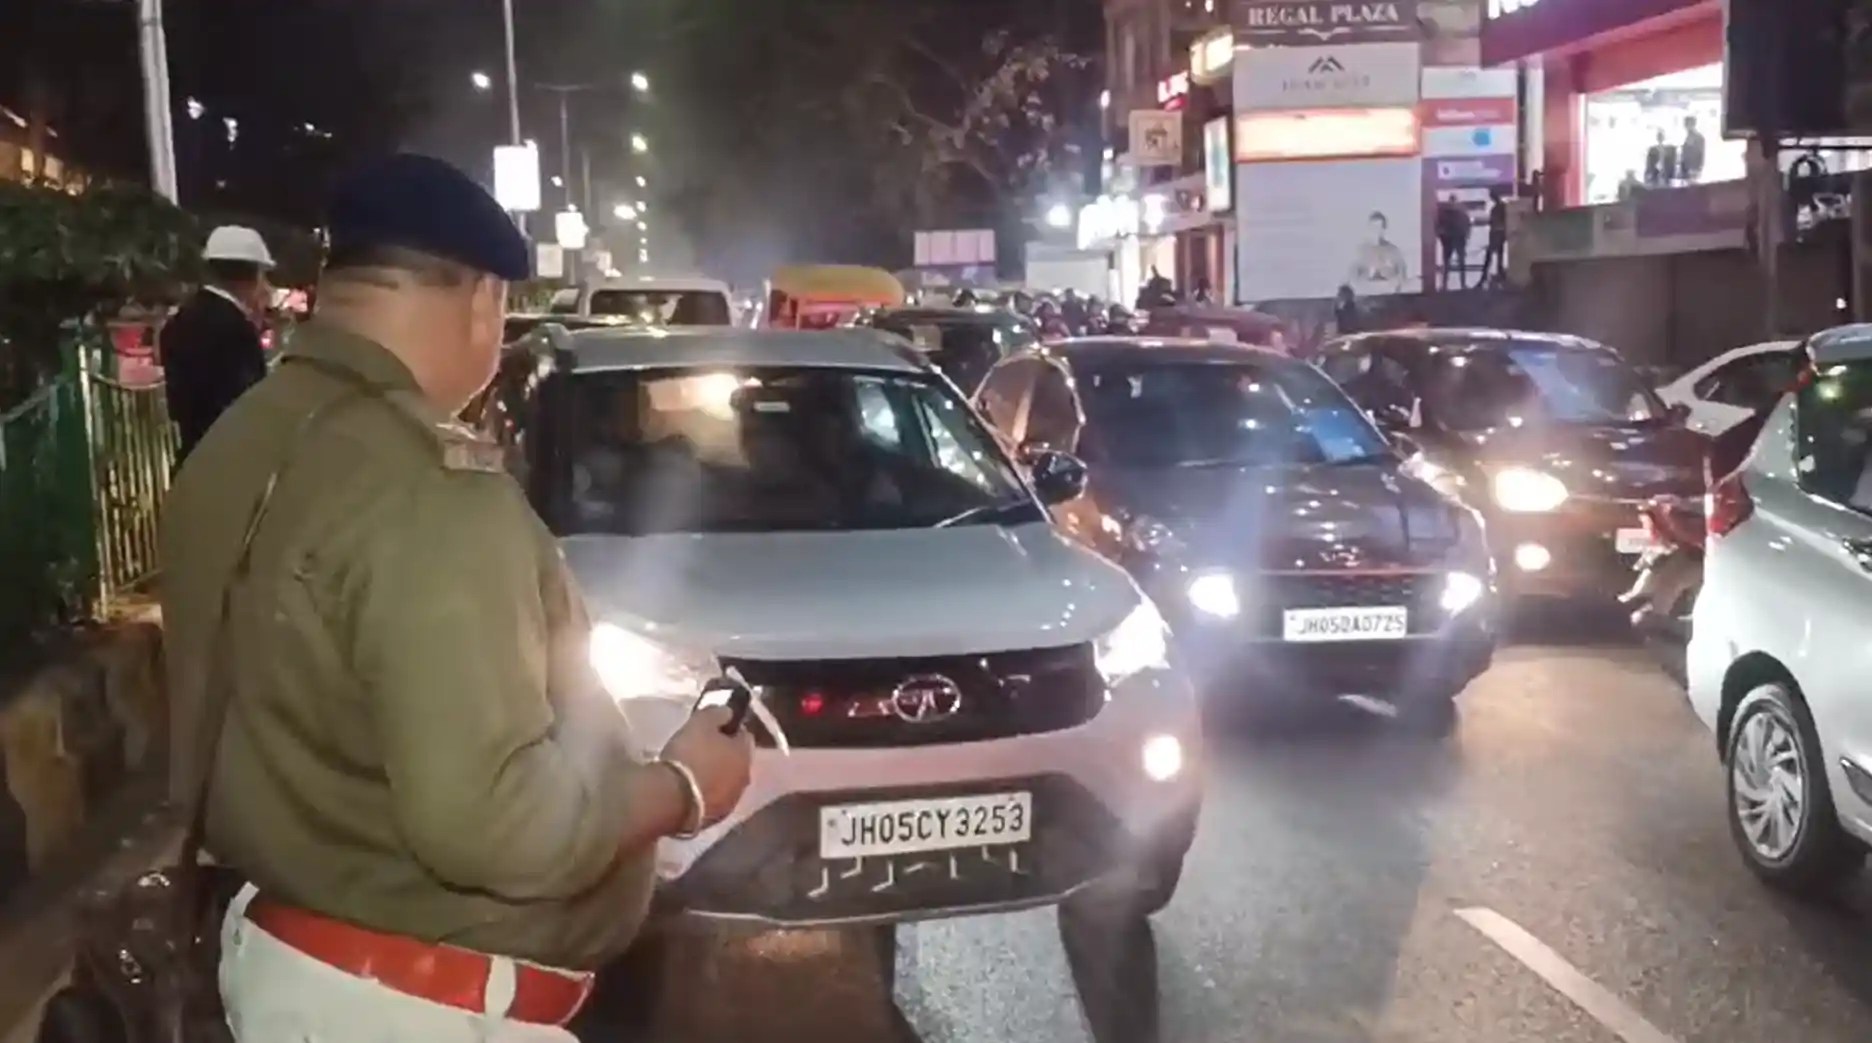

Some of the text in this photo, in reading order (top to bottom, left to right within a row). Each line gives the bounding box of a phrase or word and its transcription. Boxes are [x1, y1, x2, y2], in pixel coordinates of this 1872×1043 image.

[1248, 3, 1400, 25] REGAL PLAZA
[841, 802, 1024, 847] JH05CY3253
